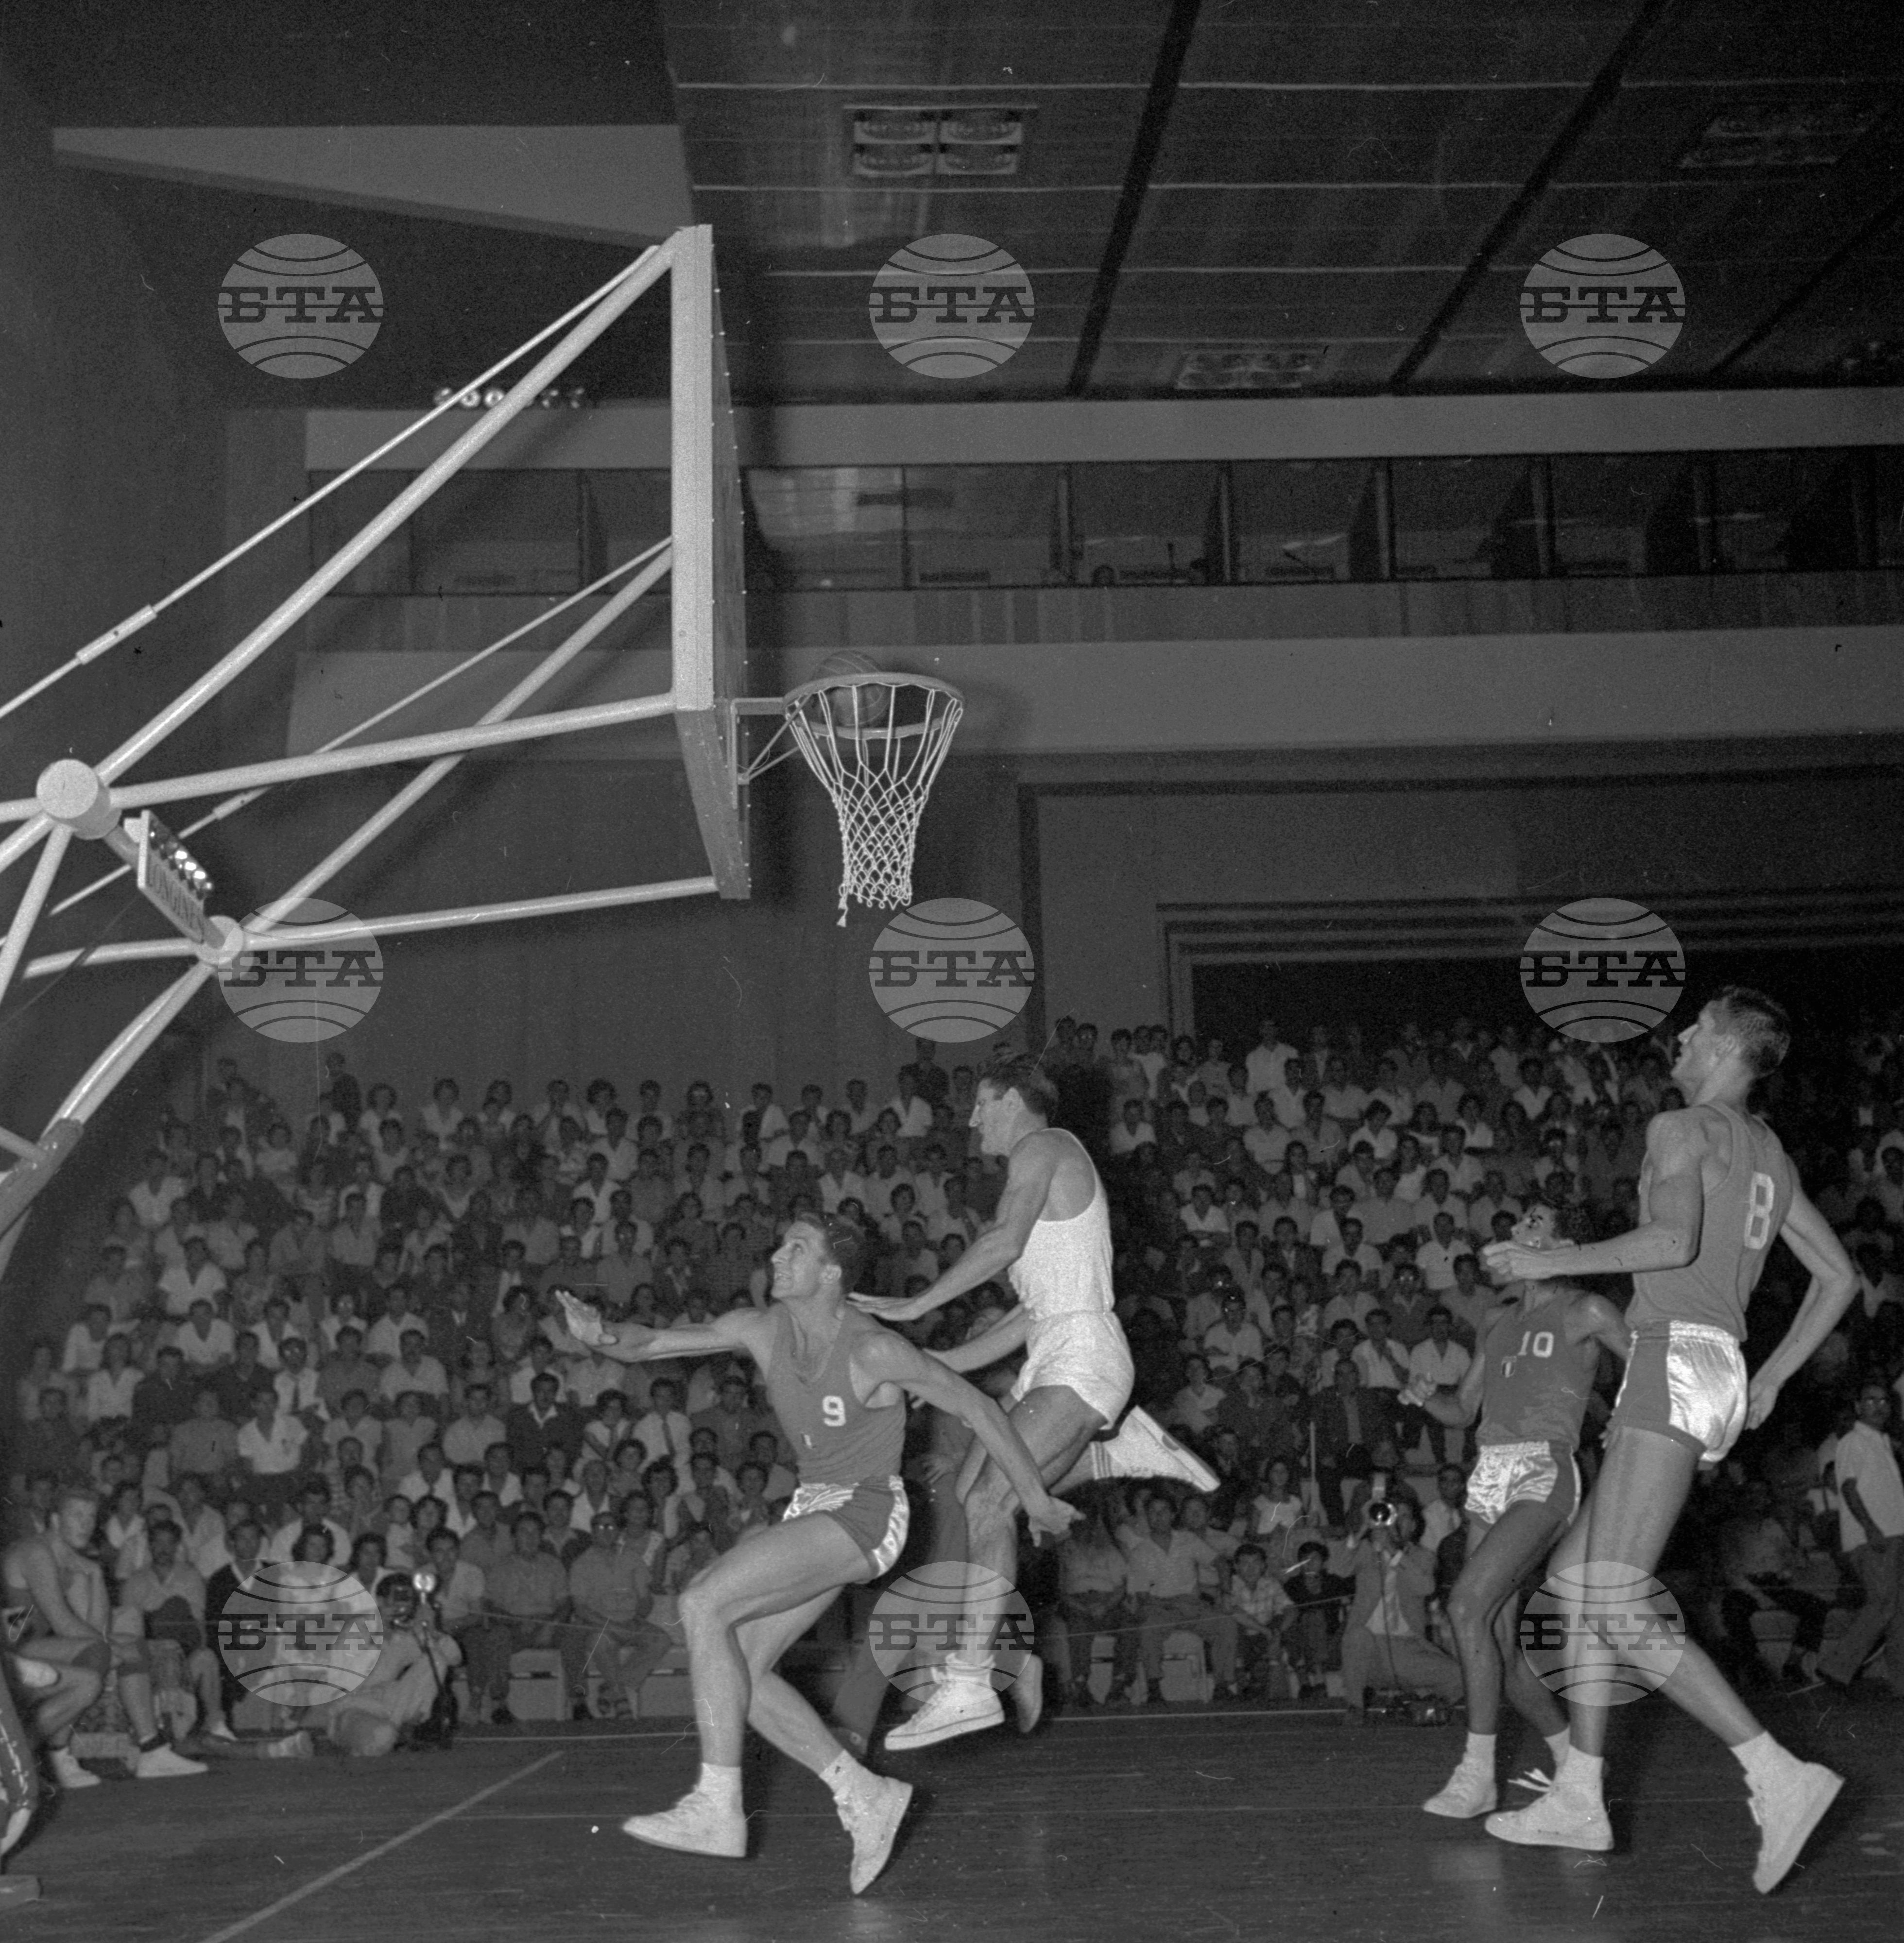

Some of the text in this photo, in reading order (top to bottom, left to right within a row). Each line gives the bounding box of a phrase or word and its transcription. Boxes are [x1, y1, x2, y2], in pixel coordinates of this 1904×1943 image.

[1744, 1171, 1774, 1249] 8
[1518, 1331, 1554, 1358] 10
[823, 1395, 846, 1426] 9
